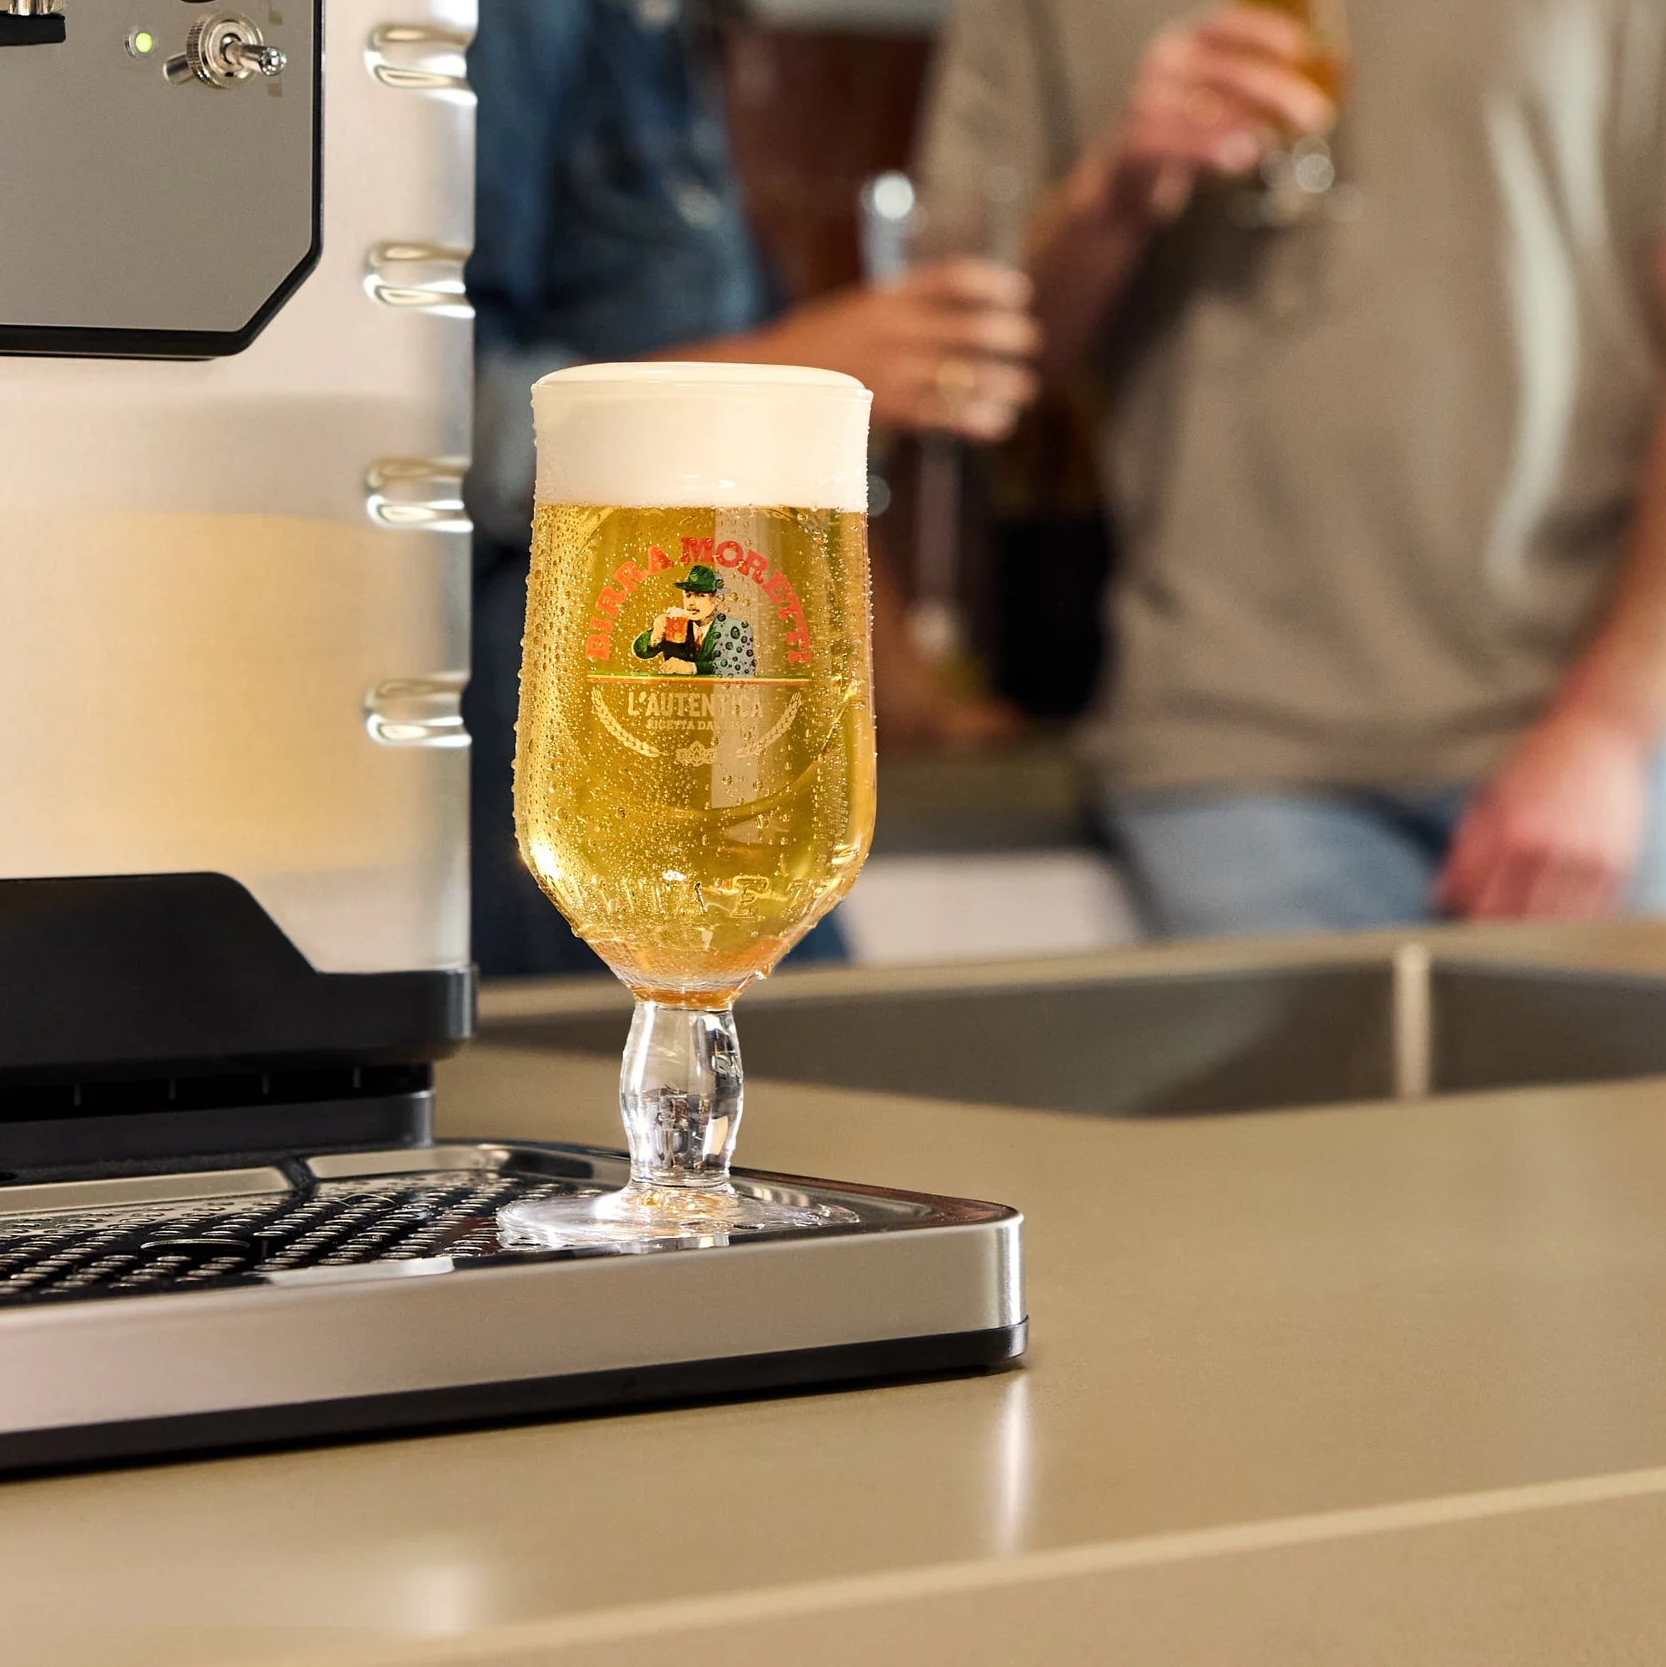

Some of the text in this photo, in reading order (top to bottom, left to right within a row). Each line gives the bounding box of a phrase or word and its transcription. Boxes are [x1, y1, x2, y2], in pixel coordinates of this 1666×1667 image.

[585, 536, 811, 664] BIRRA MORETTI
[628, 691, 764, 718] L'AUTENTICA
